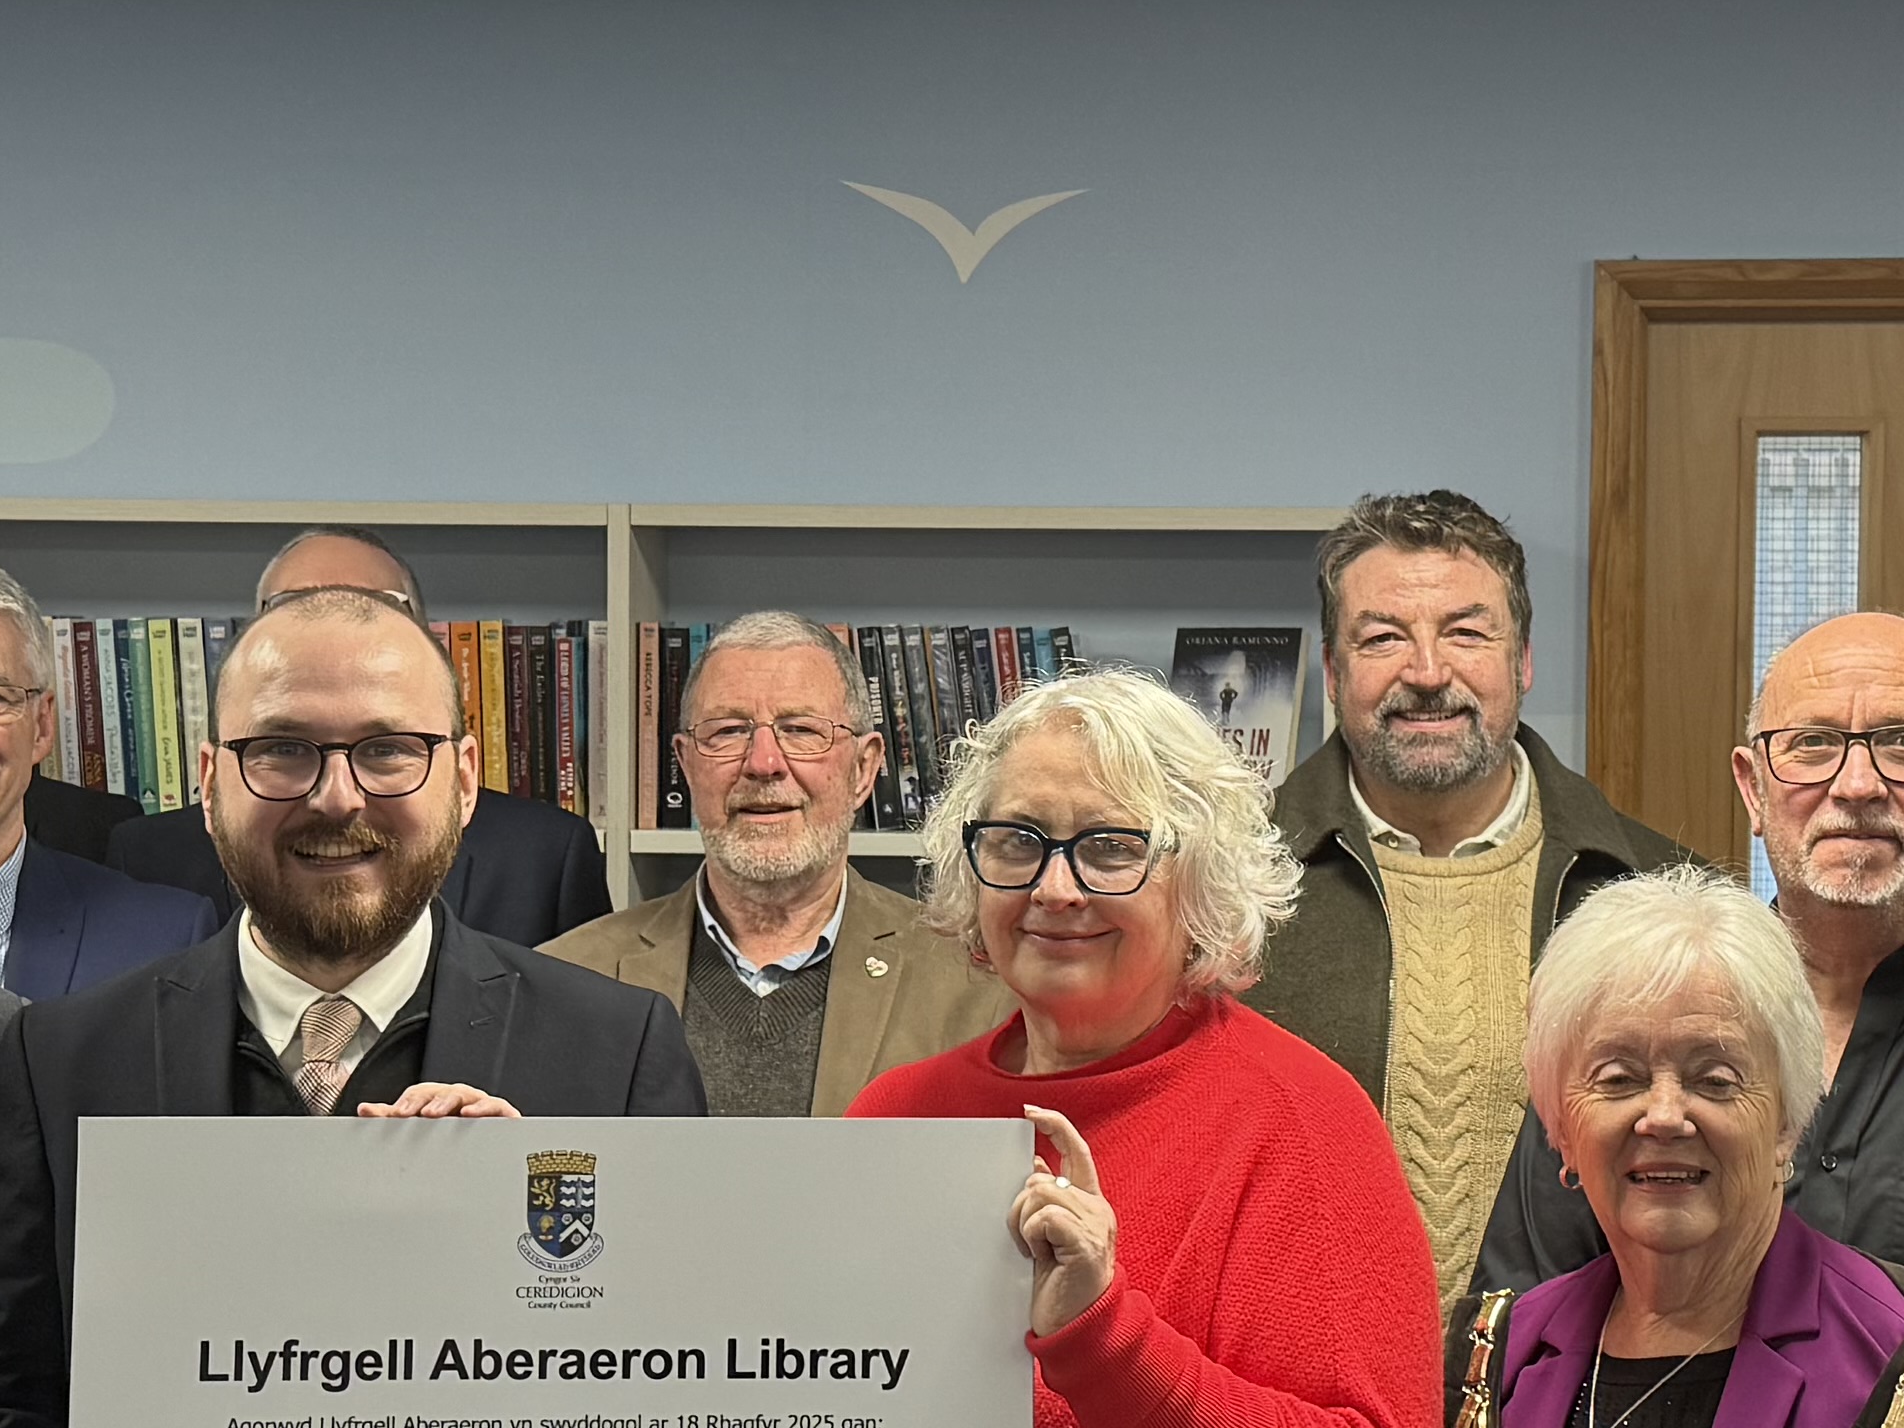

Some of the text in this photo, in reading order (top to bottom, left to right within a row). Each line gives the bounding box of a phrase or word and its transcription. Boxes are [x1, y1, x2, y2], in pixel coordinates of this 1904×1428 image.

[1249, 728, 1271, 757] IN
[515, 1286, 604, 1299] CEREDIGION
[199, 1337, 910, 1394] Llyfrgell Aberaeron Library
